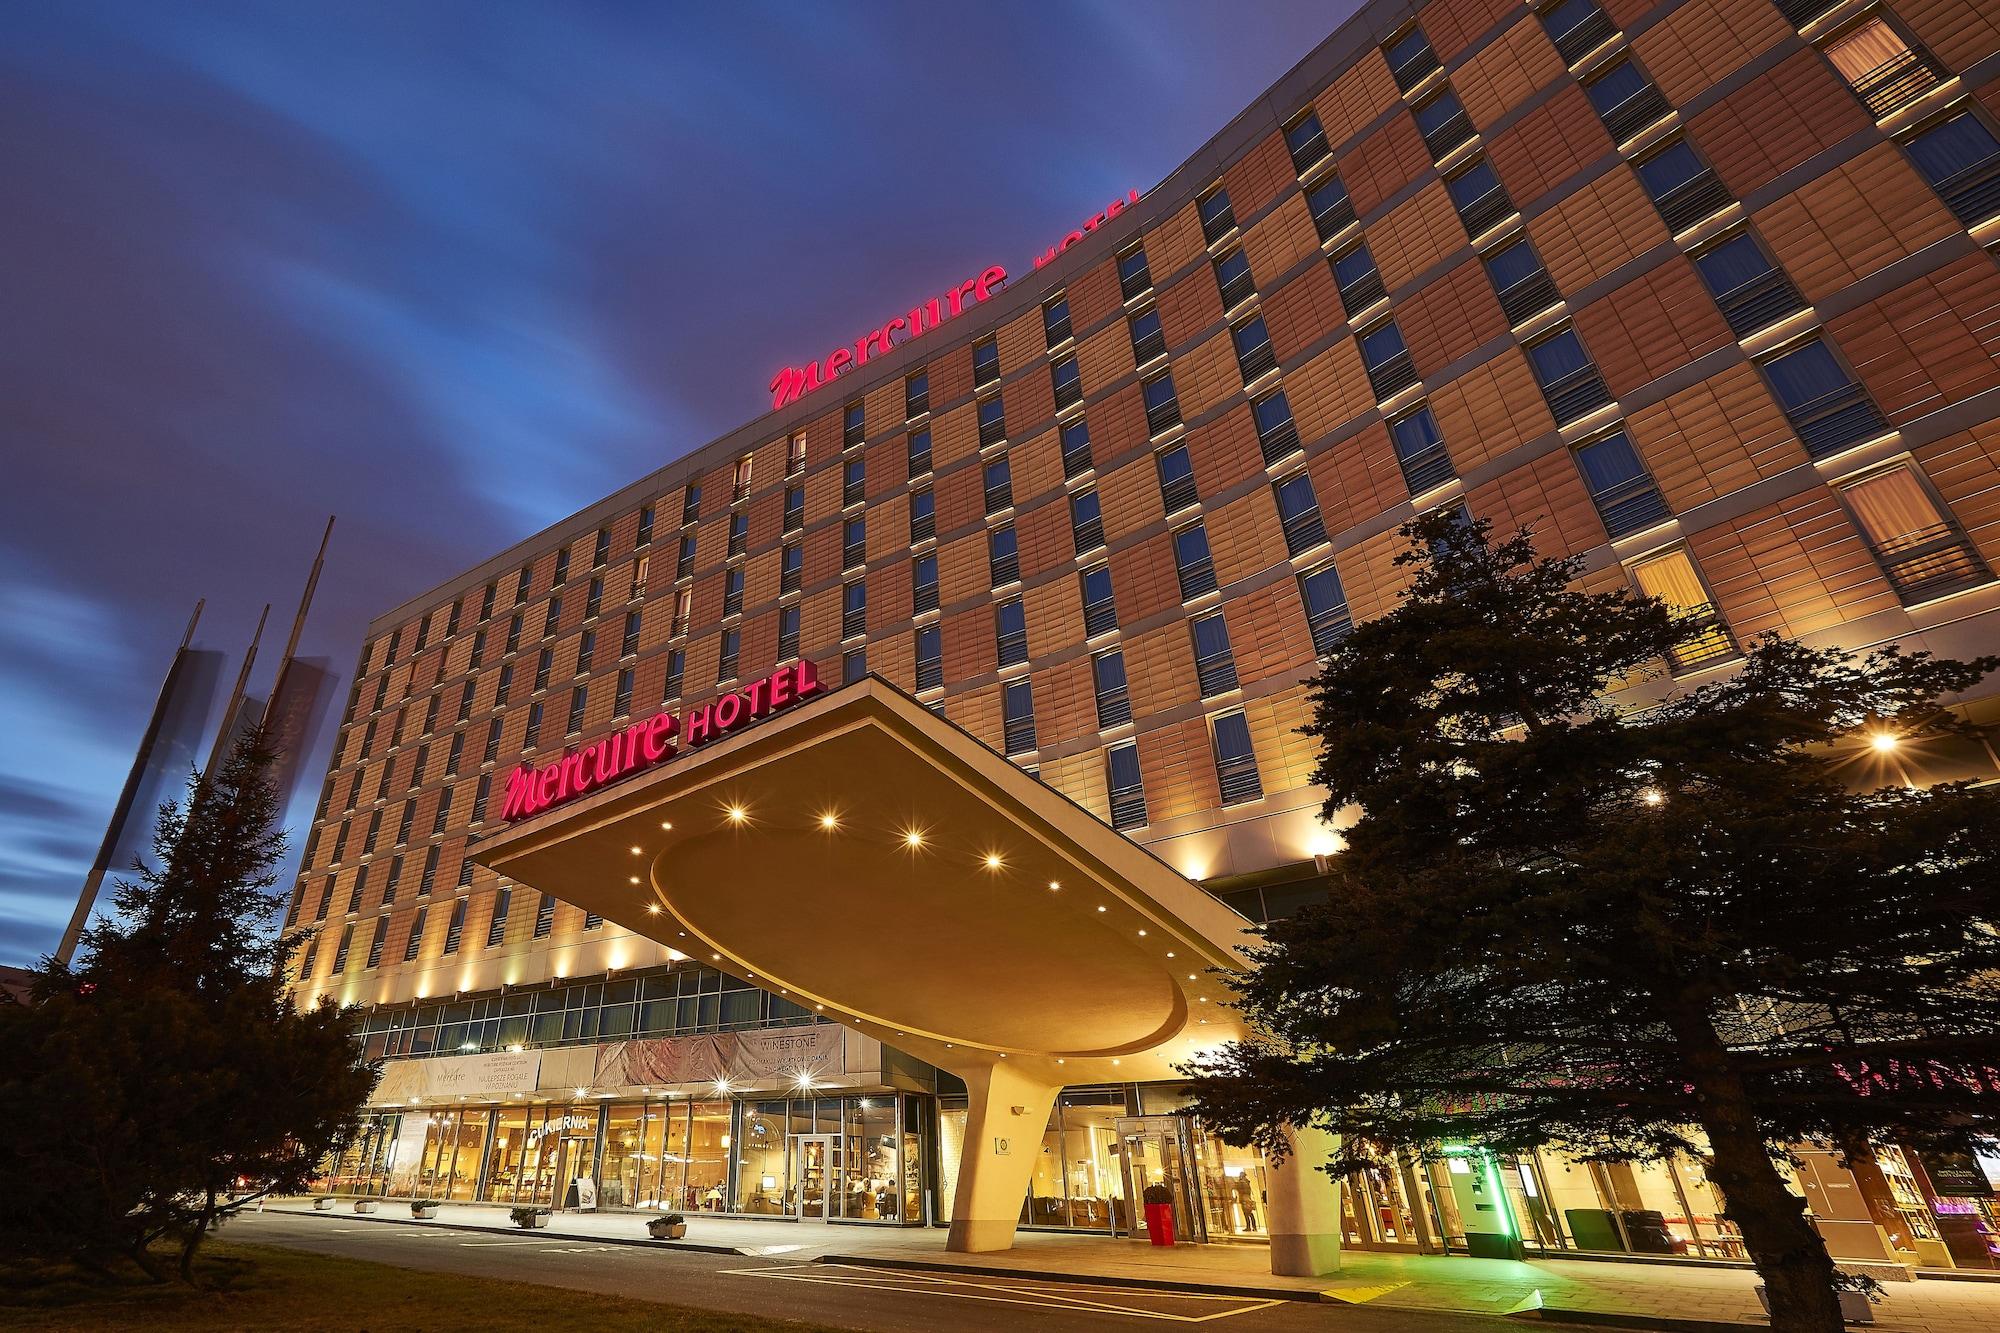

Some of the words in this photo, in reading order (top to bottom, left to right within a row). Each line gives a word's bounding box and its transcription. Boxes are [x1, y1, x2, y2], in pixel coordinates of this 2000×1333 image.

[687, 659, 828, 747] HOTEL
[760, 1037, 816, 1051] WINESTONE
[529, 1115, 589, 1140] CUKIERNIA
